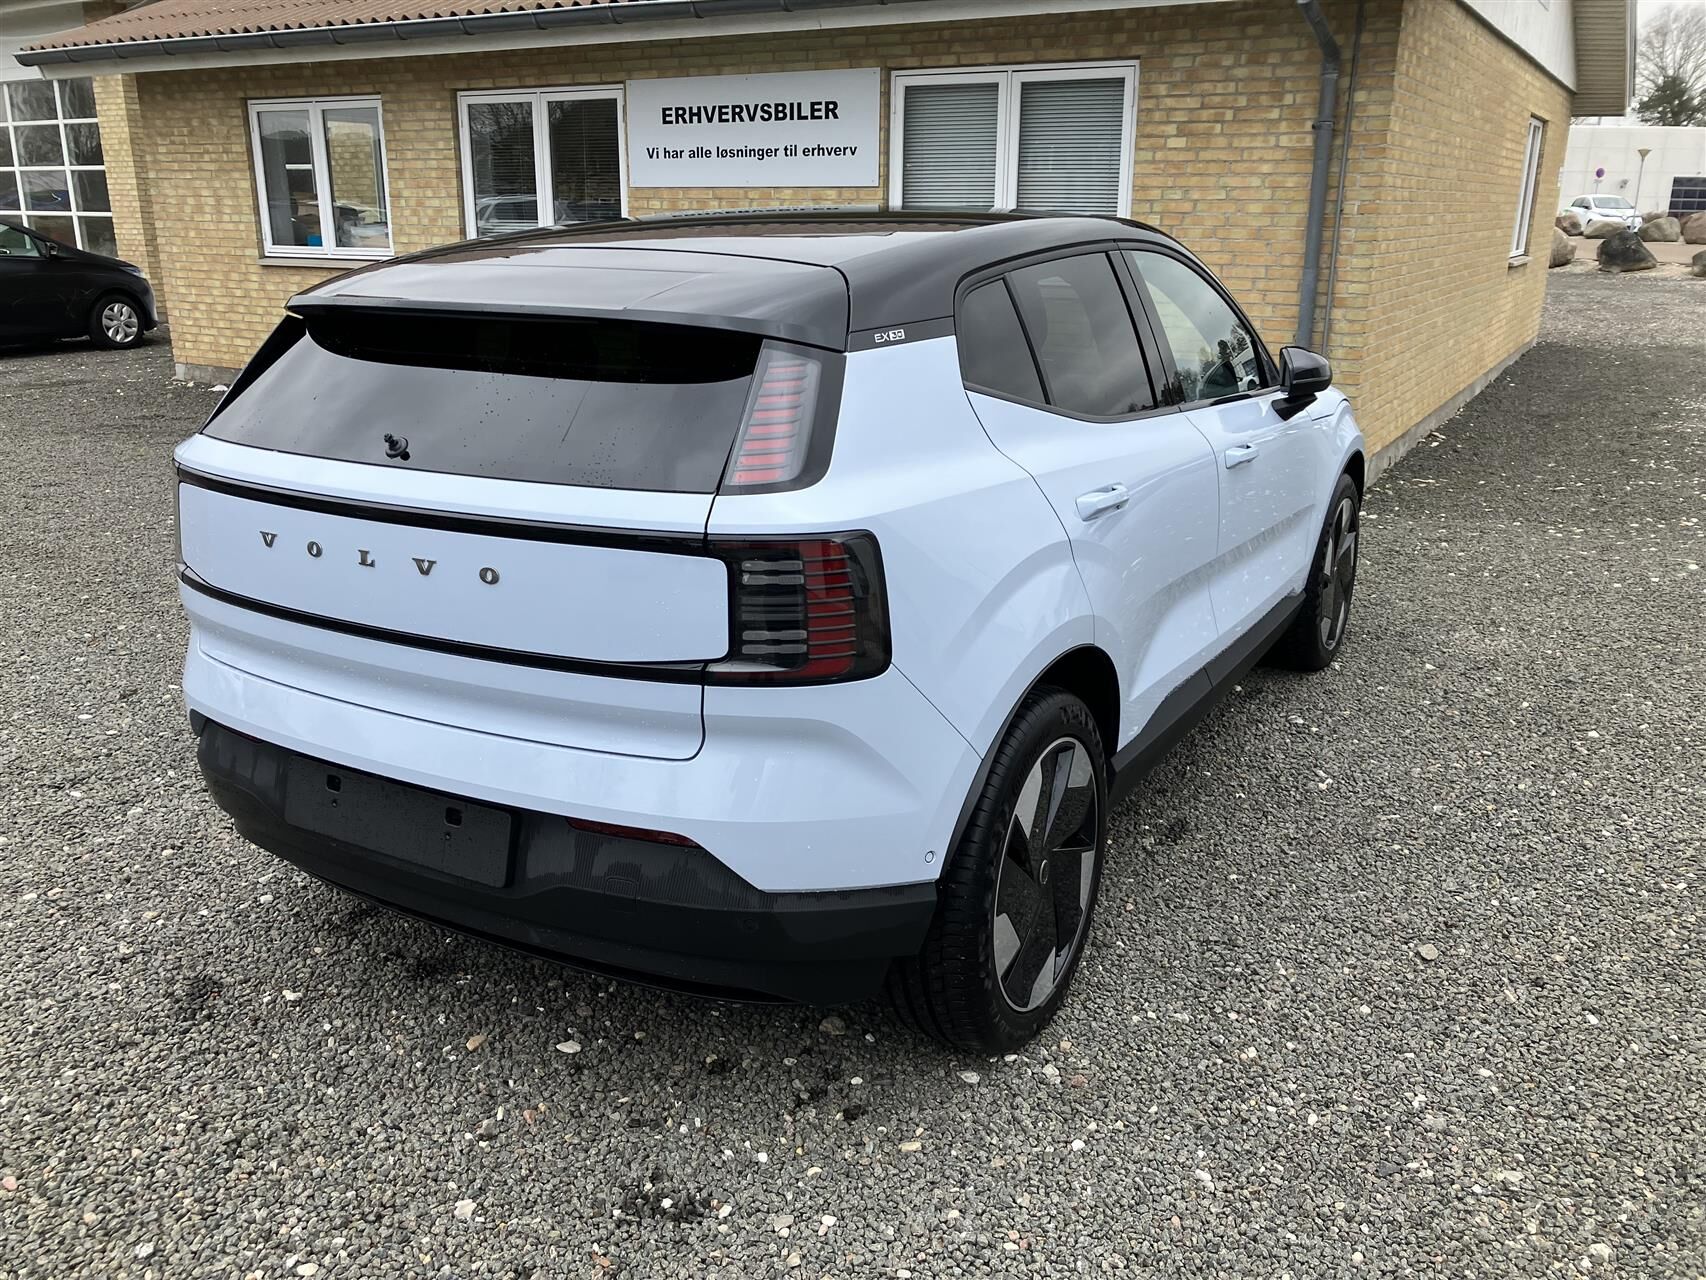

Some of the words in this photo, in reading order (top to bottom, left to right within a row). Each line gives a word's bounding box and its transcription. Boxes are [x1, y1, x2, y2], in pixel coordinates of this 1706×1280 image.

[661, 100, 839, 125] ERHVERVSBILER
[646, 147, 660, 159] Vi
[663, 147, 685, 159] har
[688, 146, 712, 159] alle
[716, 145, 780, 161] løsninger
[784, 144, 798, 157] til
[802, 144, 858, 157] erhverv
[874, 329, 905, 343] EX30
[259, 530, 501, 585] VOLVO
